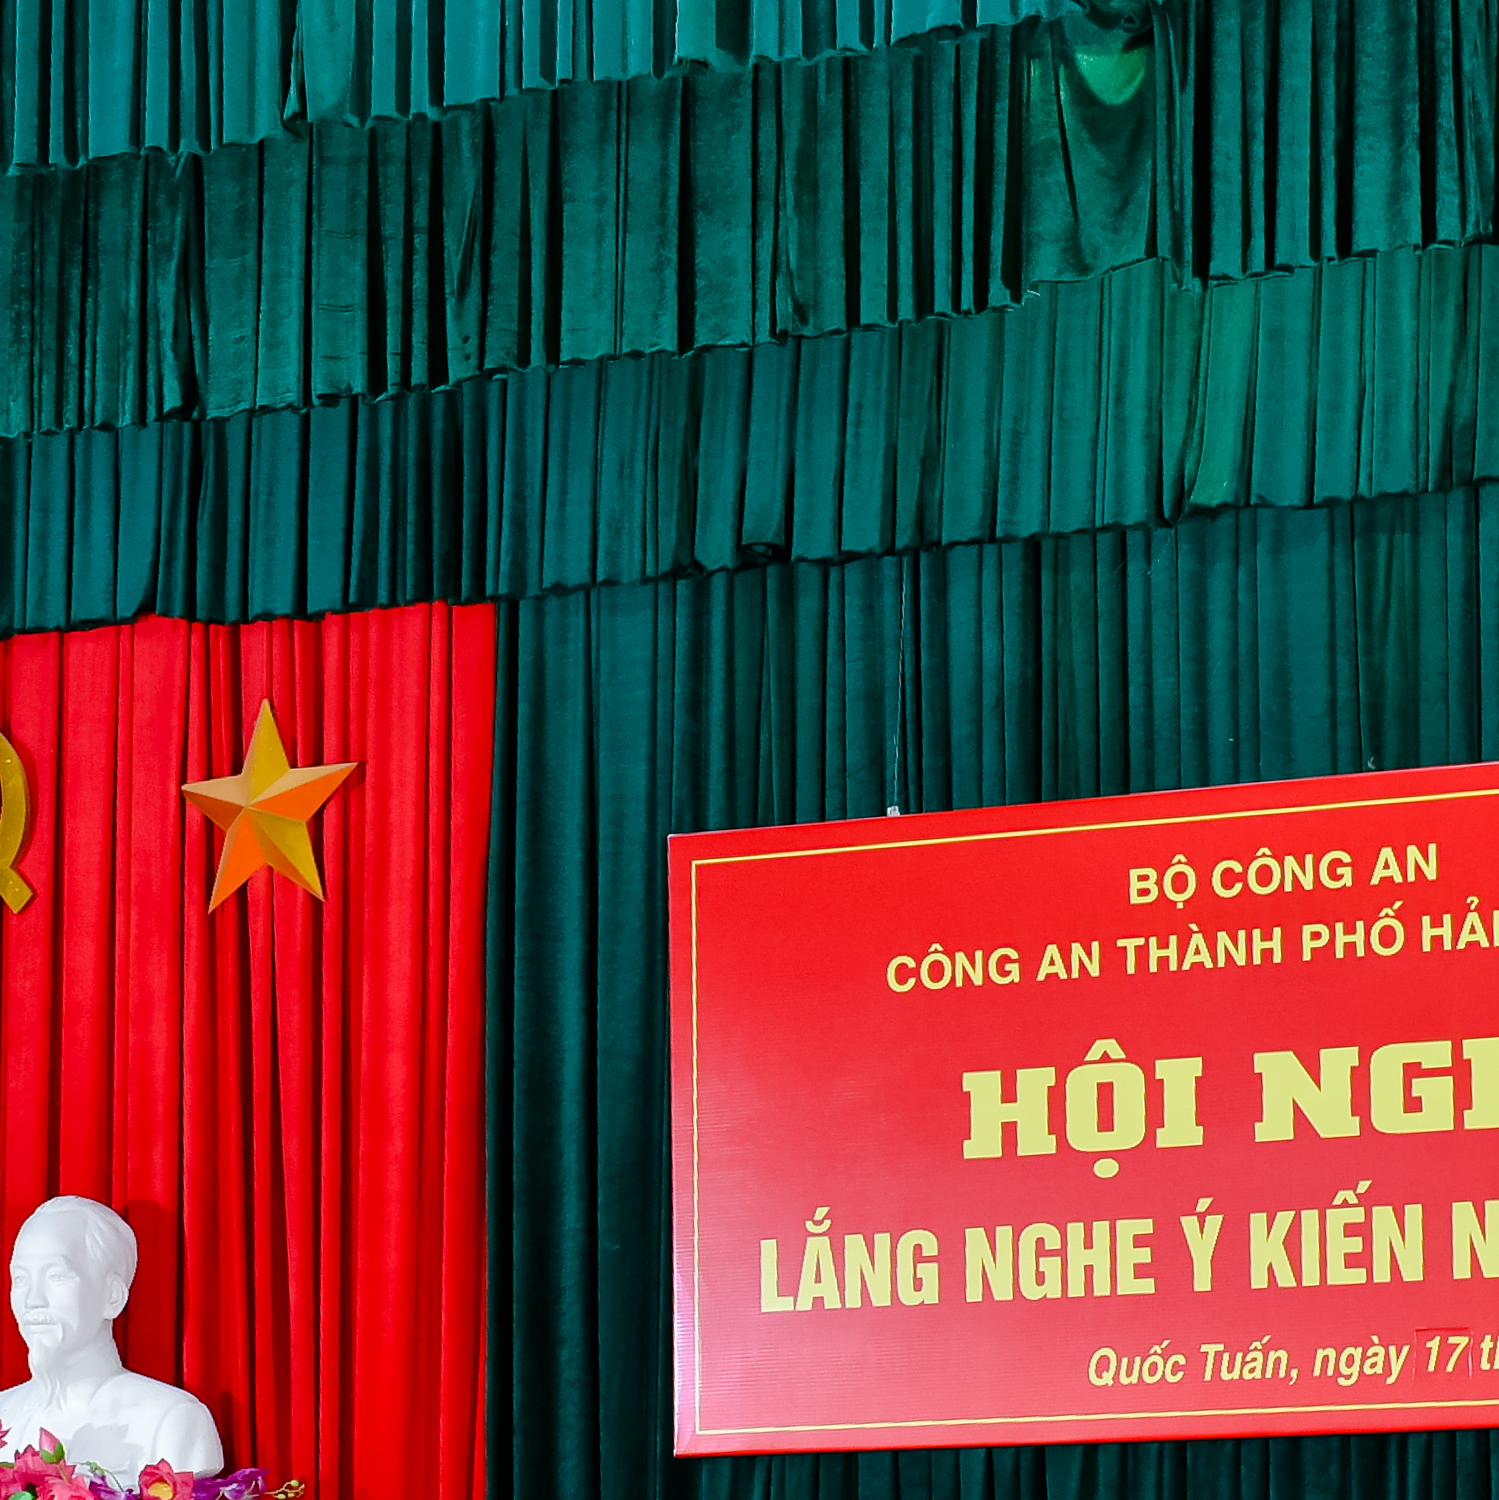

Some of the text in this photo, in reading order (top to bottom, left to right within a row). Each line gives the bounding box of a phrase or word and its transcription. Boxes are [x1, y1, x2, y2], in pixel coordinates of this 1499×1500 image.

[1130, 843, 1437, 910] BỘ CÔNG AN
[887, 944, 1020, 992] CÔNG
[1037, 941, 1099, 981] AN
[1117, 919, 1281, 974] THÀNH
[1302, 899, 1404, 961] PHỐ
[962, 1039, 1203, 1178] HỘI
[760, 1206, 939, 1312] LẮNG
[965, 1219, 1155, 1302] NGHE
[1180, 1198, 1224, 1291] Ý
[1250, 1180, 1423, 1289] KIẾN
[1089, 1340, 1186, 1386] Quốc
[1200, 1335, 1298, 1385] Tuấn,
[1313, 1334, 1410, 1386] ngày
[1426, 1336, 1469, 1372] 17
